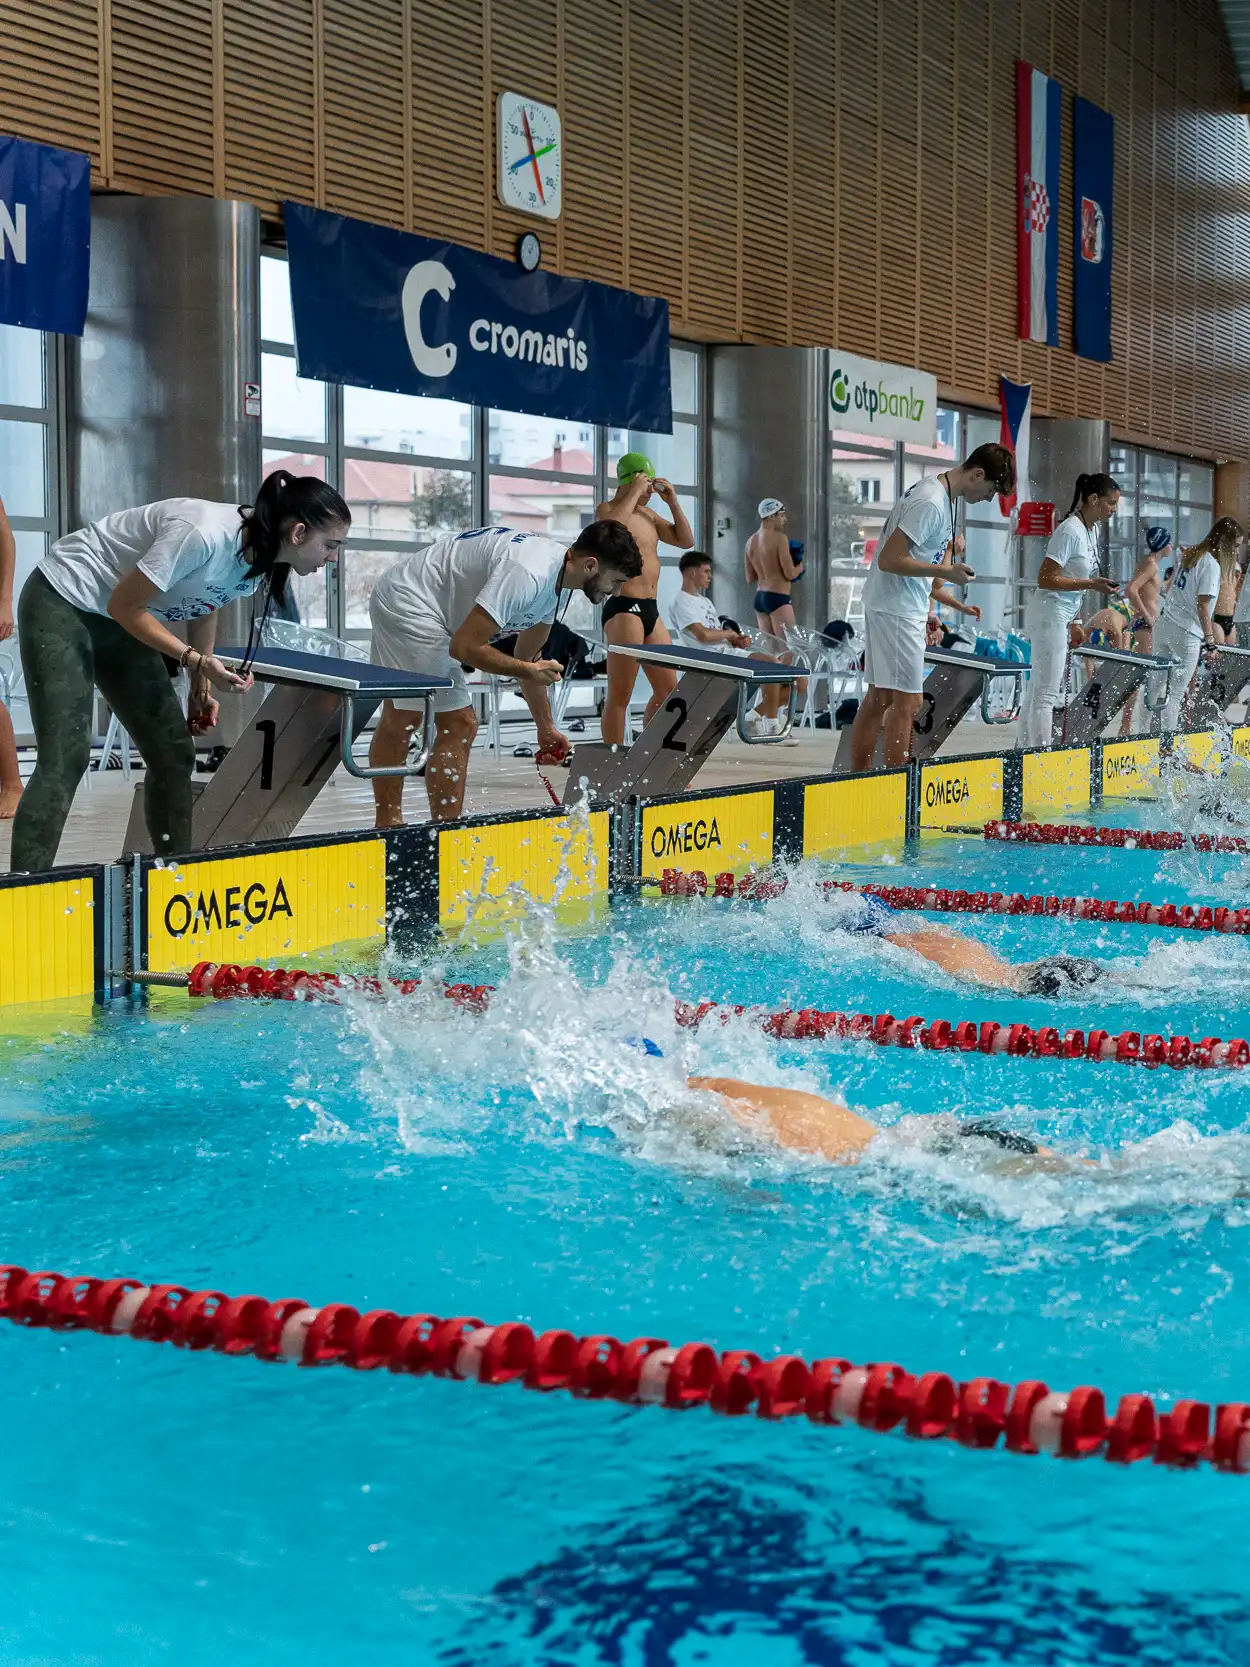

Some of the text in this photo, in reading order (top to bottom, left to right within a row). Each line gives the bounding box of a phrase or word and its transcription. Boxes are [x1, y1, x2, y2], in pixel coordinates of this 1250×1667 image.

[469, 318, 588, 372] cromaris
[662, 697, 687, 752] 2
[1082, 683, 1102, 719] 4
[256, 720, 276, 790] 1
[926, 777, 970, 808] OMEGA
[651, 816, 722, 857] OMEGA
[164, 876, 294, 938] OMEGA
